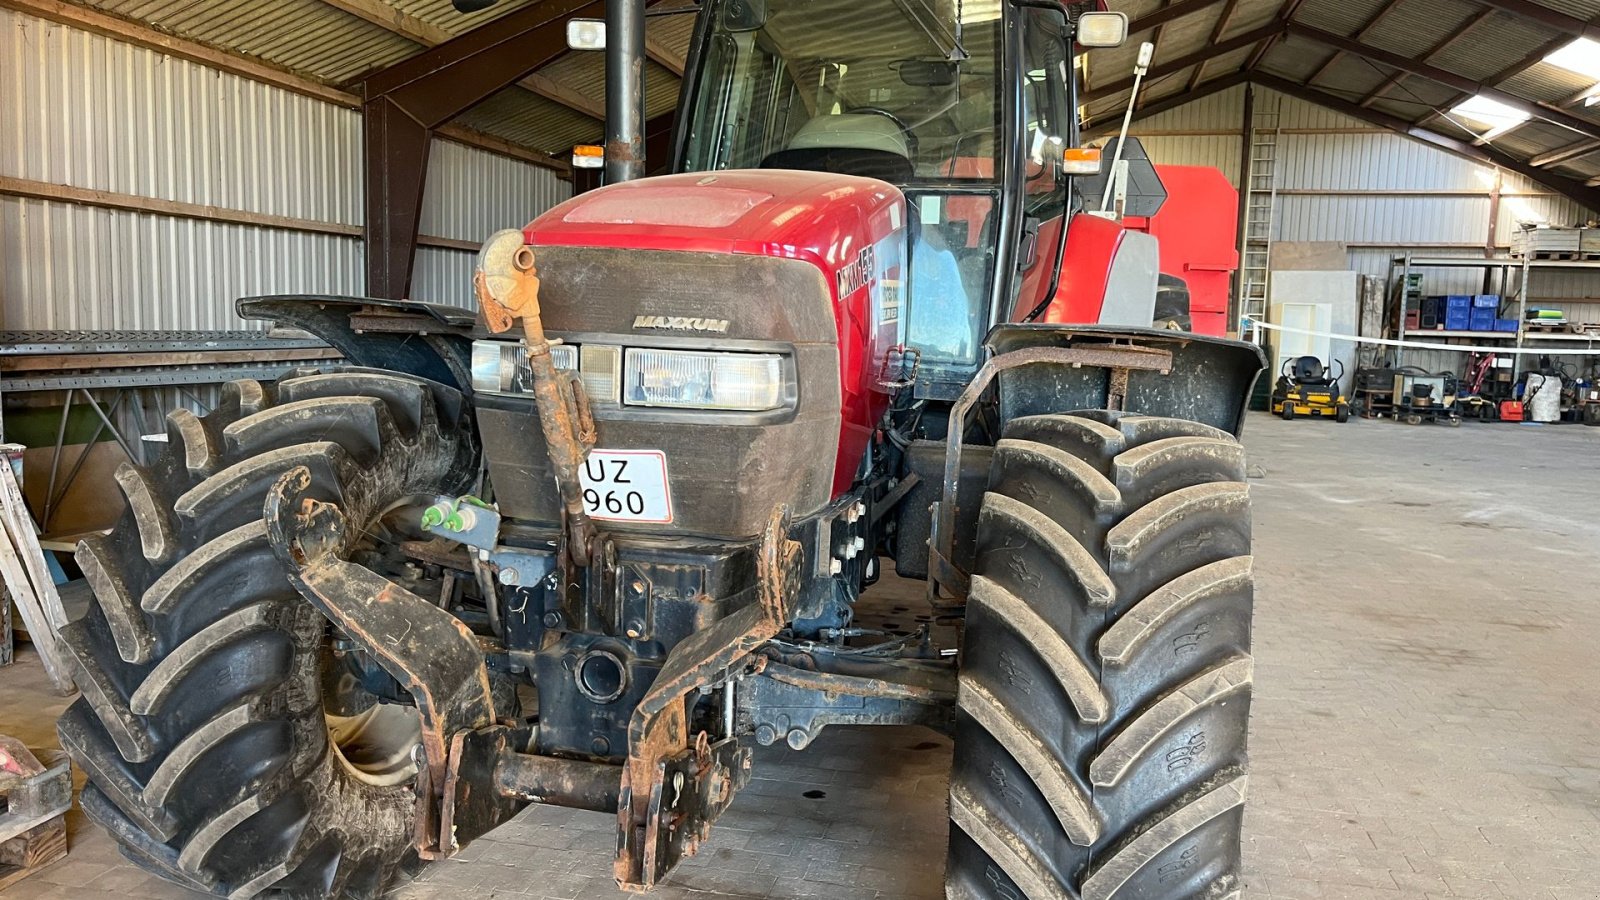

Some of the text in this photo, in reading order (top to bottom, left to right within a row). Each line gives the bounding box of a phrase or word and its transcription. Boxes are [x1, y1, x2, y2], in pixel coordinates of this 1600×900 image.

[632, 315, 729, 333] MAXXUM
[585, 459, 631, 483] UZ
[583, 488, 644, 515] 960
